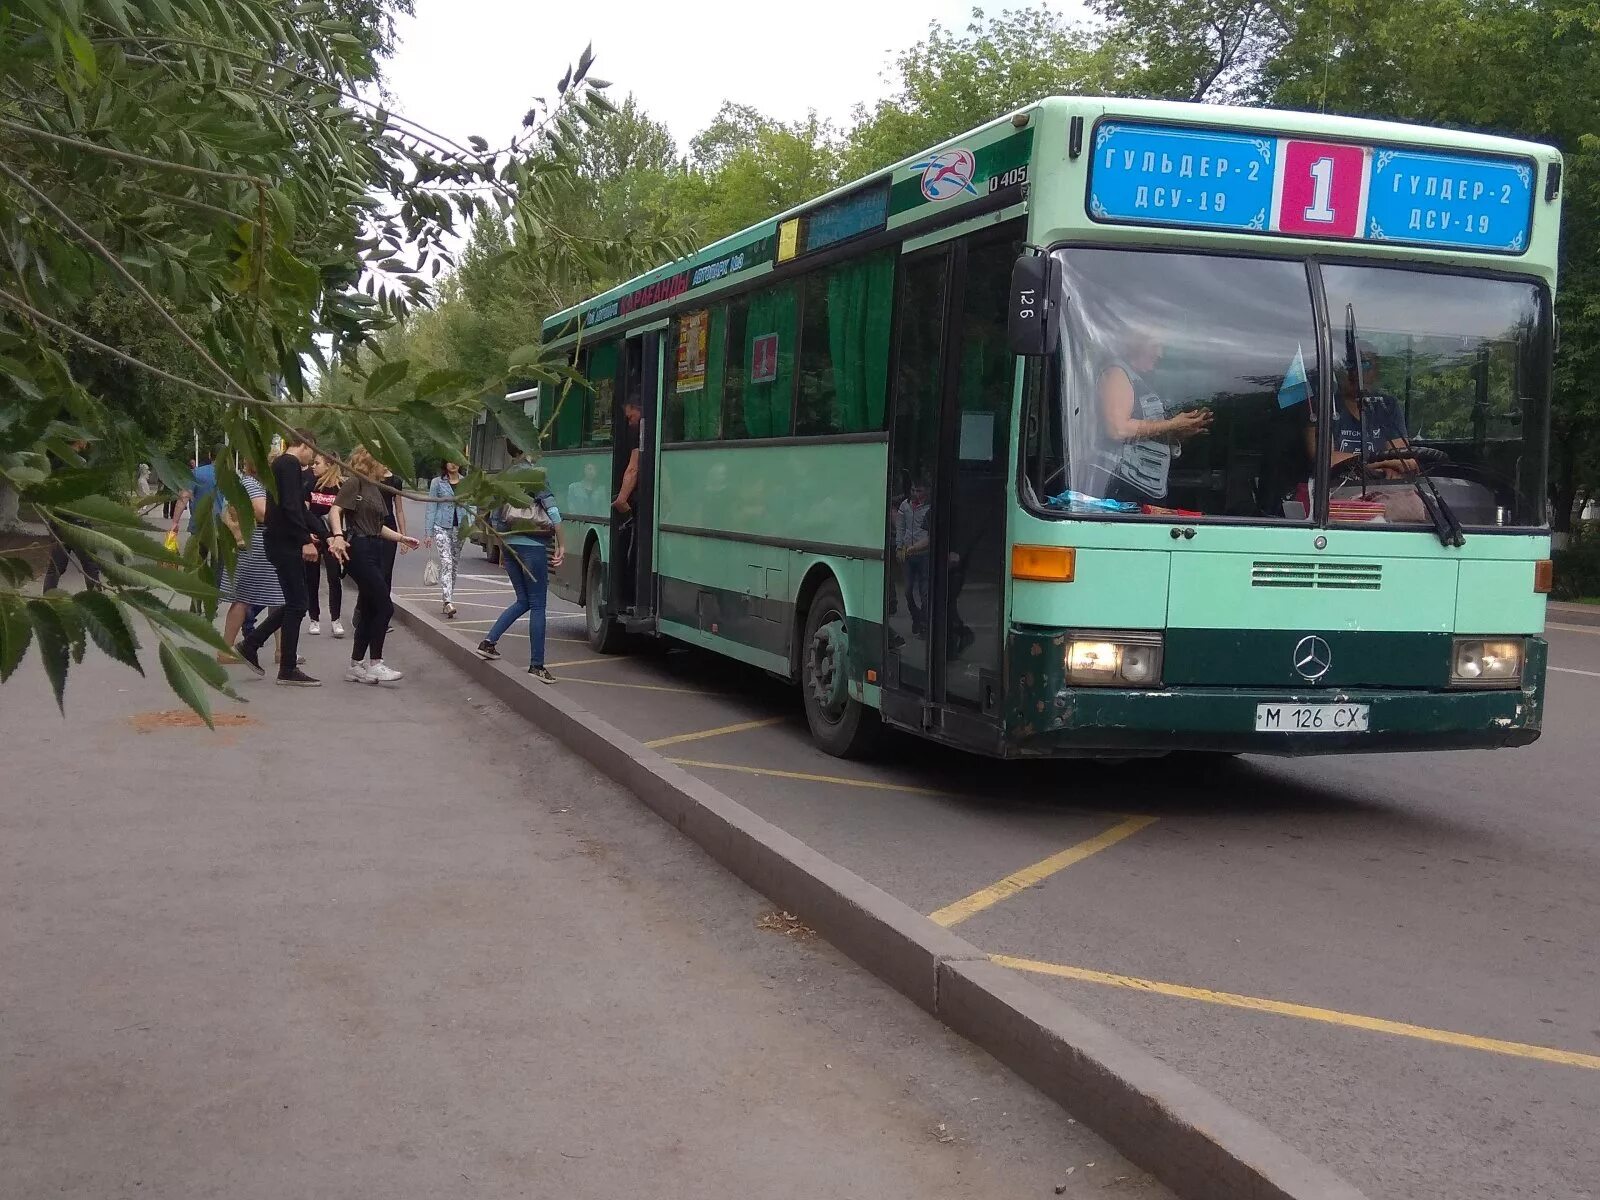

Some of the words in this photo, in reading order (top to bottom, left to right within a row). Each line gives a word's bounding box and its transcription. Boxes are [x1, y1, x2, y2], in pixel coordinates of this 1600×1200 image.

[1000, 166, 1026, 188] 405
[1105, 148, 1260, 181] ГУЛЬДЕР-2
[1135, 186, 1226, 212] ДСУ-19
[1304, 156, 1335, 223] 1
[1409, 208, 1489, 234] ДСУ-19
[1019, 288, 1035, 319] 126
[1291, 708, 1323, 728] 126
